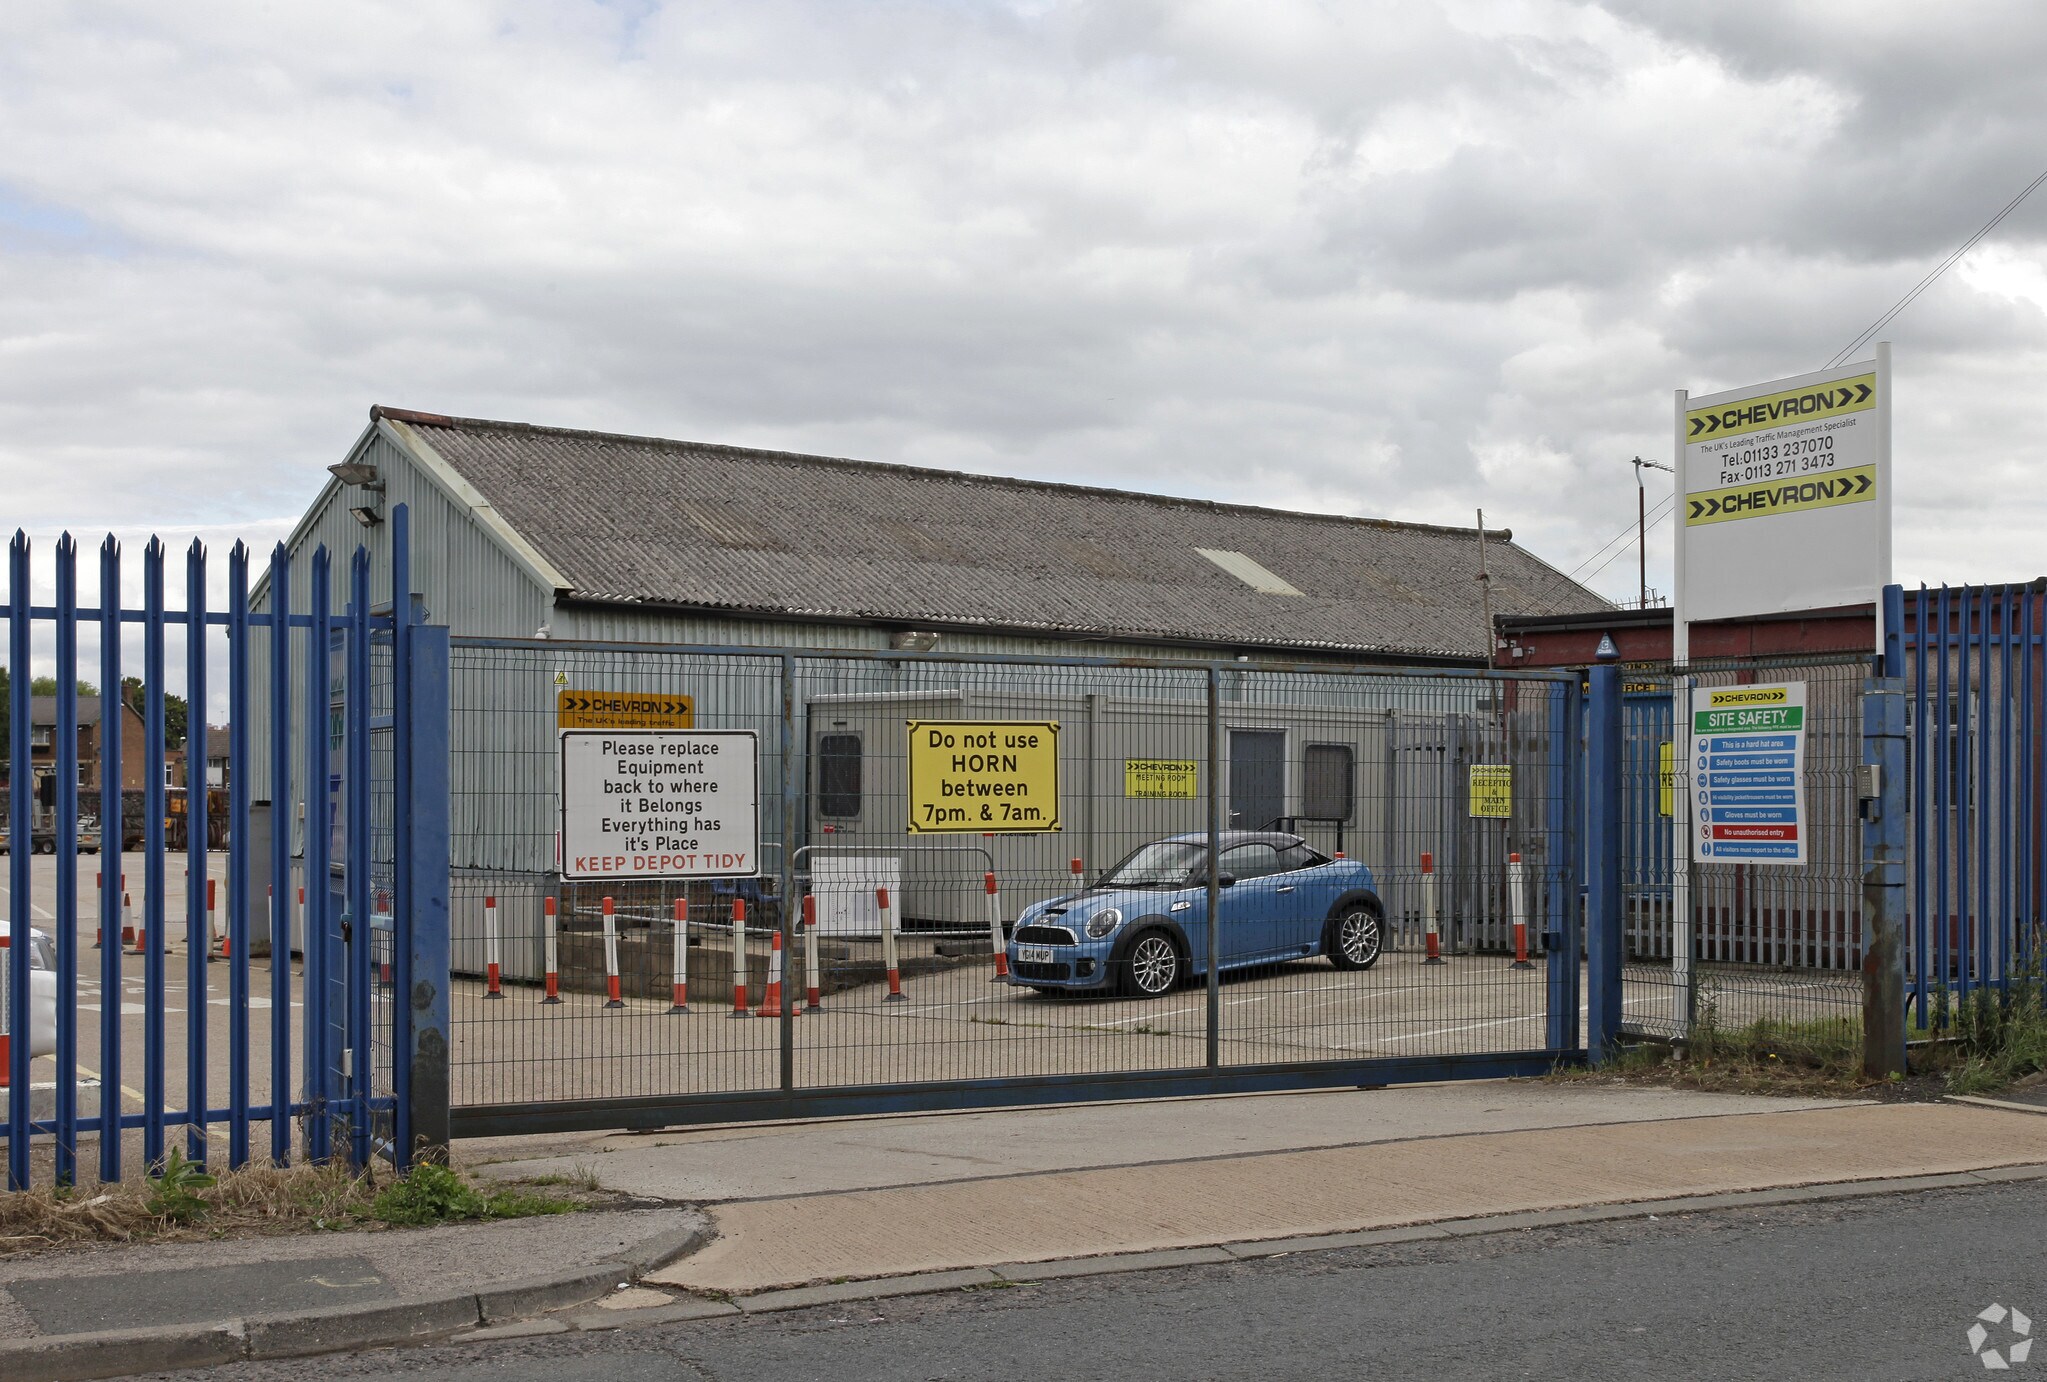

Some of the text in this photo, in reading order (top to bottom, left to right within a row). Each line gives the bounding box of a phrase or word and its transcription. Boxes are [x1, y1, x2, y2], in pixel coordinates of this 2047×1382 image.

[1722, 390, 1834, 429] CHEVRON
[1701, 418, 1856, 454] The UK's Leading Traffic Management Specialist
[1722, 436, 1834, 468] Tel:01133 237070
[1720, 453, 1834, 484] Fax-0113 271 3473
[1722, 480, 1834, 514] CHEVRON
[592, 698, 662, 714] CHEVRON
[1725, 692, 1771, 702] CHEVRON
[595, 717, 616, 725] UK's
[618, 718, 646, 727] leading
[649, 719, 675, 727] traffic
[1708, 710, 1788, 726] SITE SAFETY
[929, 730, 1038, 748] Do not use
[602, 740, 719, 758] Please replace
[618, 760, 704, 776] Equipment
[952, 754, 1018, 772] HORN
[1716, 758, 1732, 767] Safety
[604, 779, 718, 794] back to where
[942, 778, 1028, 797] between
[1713, 776, 1730, 784] Safety
[1731, 776, 1752, 784] glasses
[620, 798, 702, 815] it Belongs
[922, 803, 1046, 825] 7pm. & 7am.
[602, 816, 721, 834] Everything has
[1769, 829, 1785, 837] entry
[625, 836, 699, 852] it's Place
[575, 853, 746, 872] KEEP DEPOT TIDY
